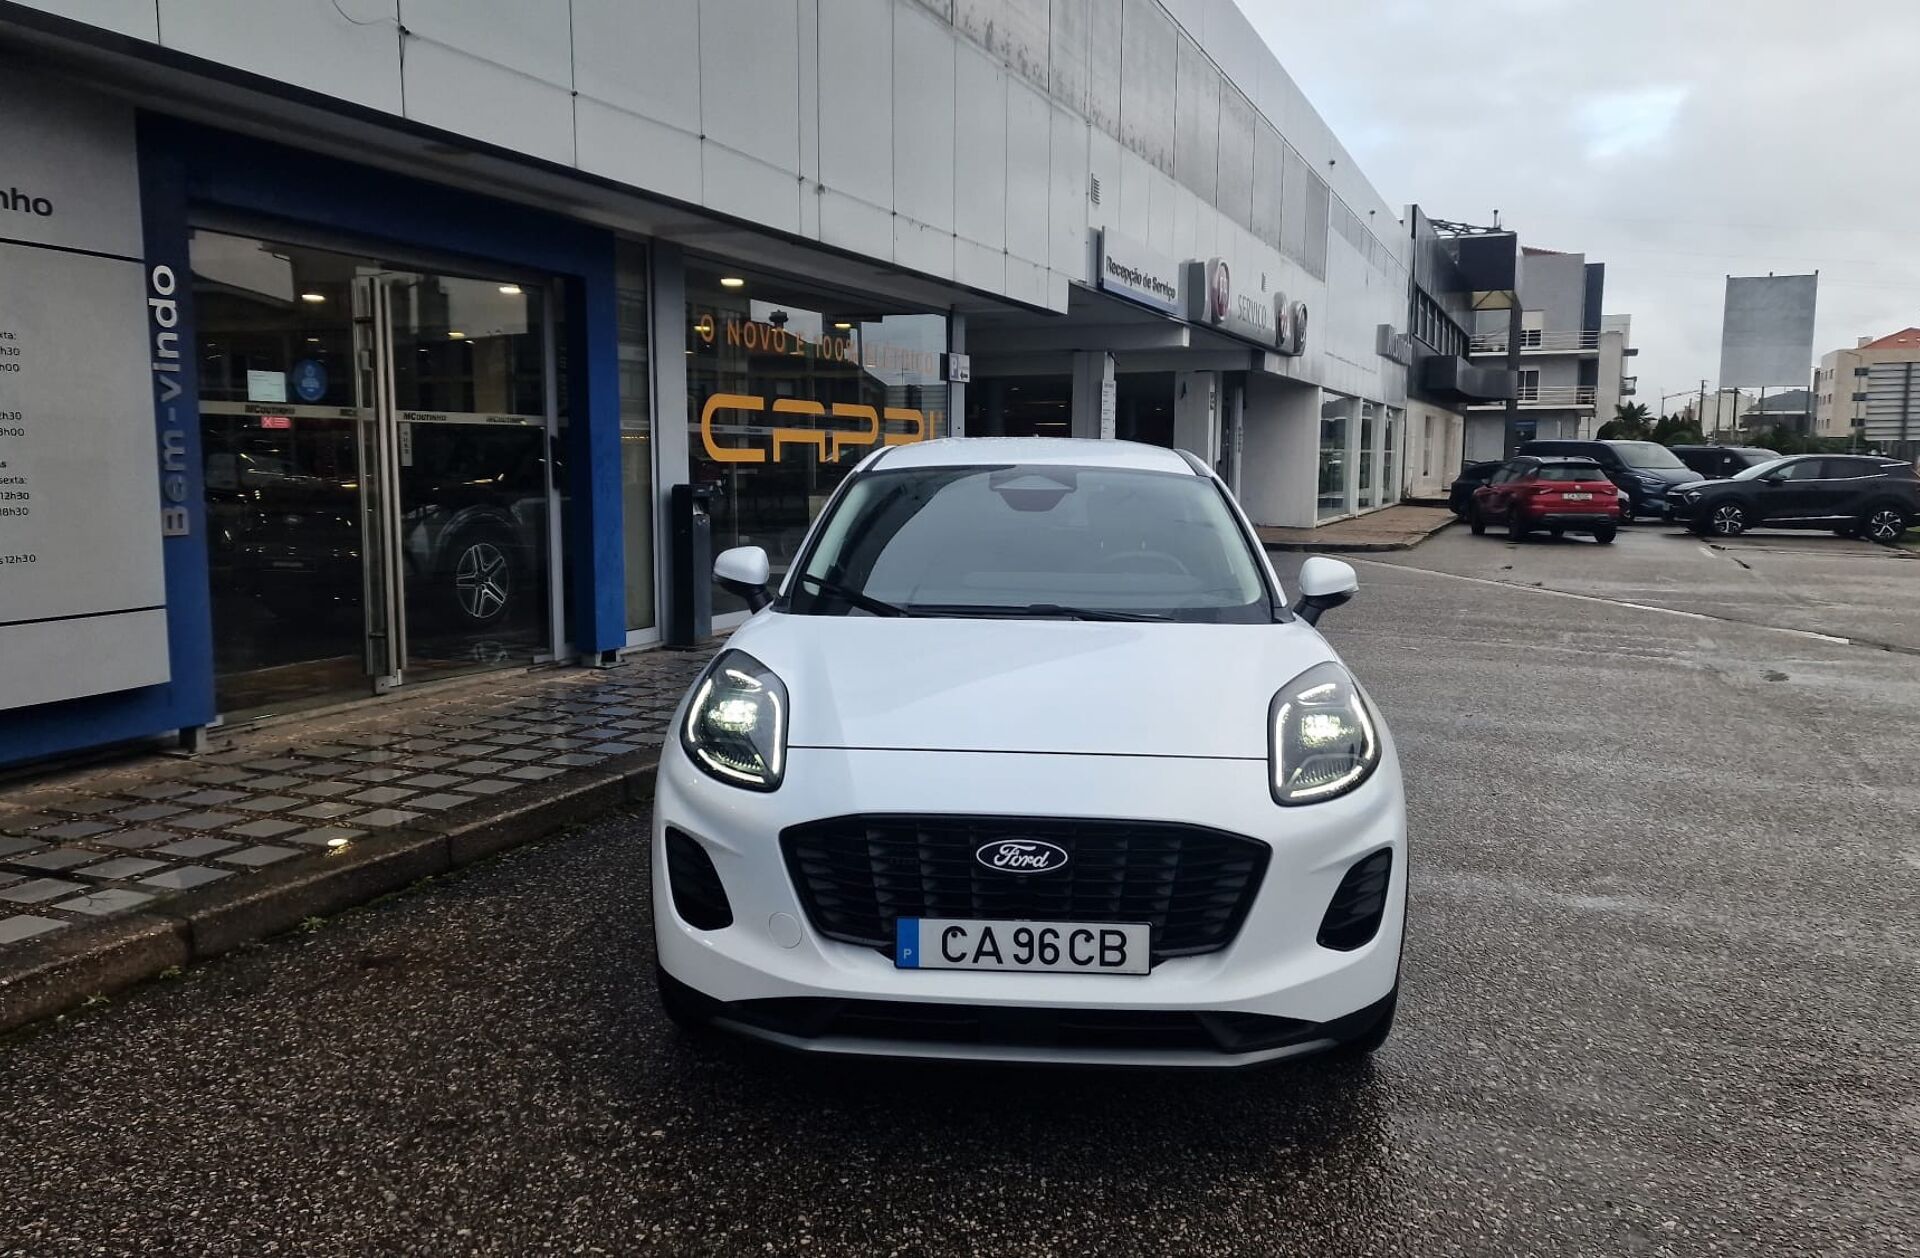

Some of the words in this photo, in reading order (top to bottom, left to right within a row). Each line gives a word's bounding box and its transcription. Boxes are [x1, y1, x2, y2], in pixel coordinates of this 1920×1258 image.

[1105, 255, 1142, 286] Recepção
[1143, 272, 1151, 289] de
[1152, 276, 1176, 301] Serviço
[727, 317, 785, 353] NOVO
[994, 843, 1050, 868] Ford
[903, 949, 912, 960] P
